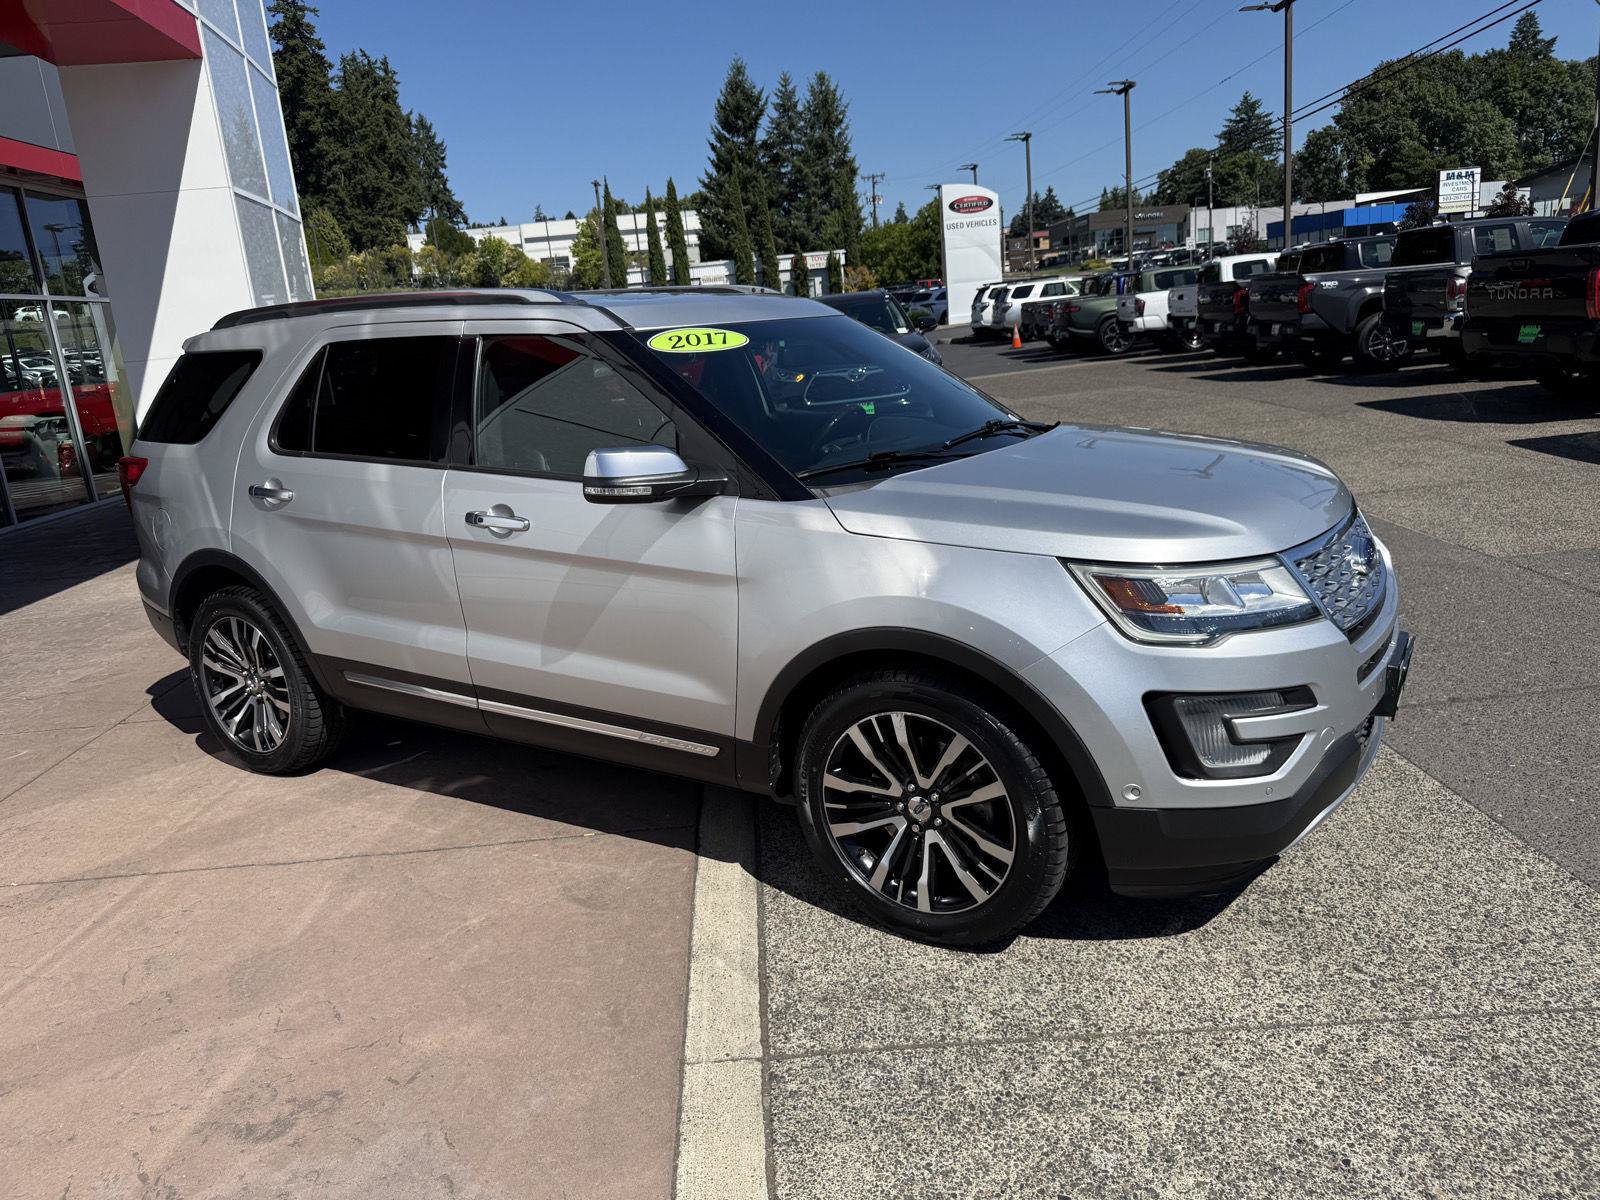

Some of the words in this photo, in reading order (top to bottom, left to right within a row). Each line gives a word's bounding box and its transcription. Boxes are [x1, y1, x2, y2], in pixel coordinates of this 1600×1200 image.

[1446, 171, 1474, 180] M&M
[946, 222, 964, 230] USED
[966, 219, 997, 228] VEHICLES
[1488, 288, 1553, 300] TUNDRA
[668, 332, 727, 349] 2017
